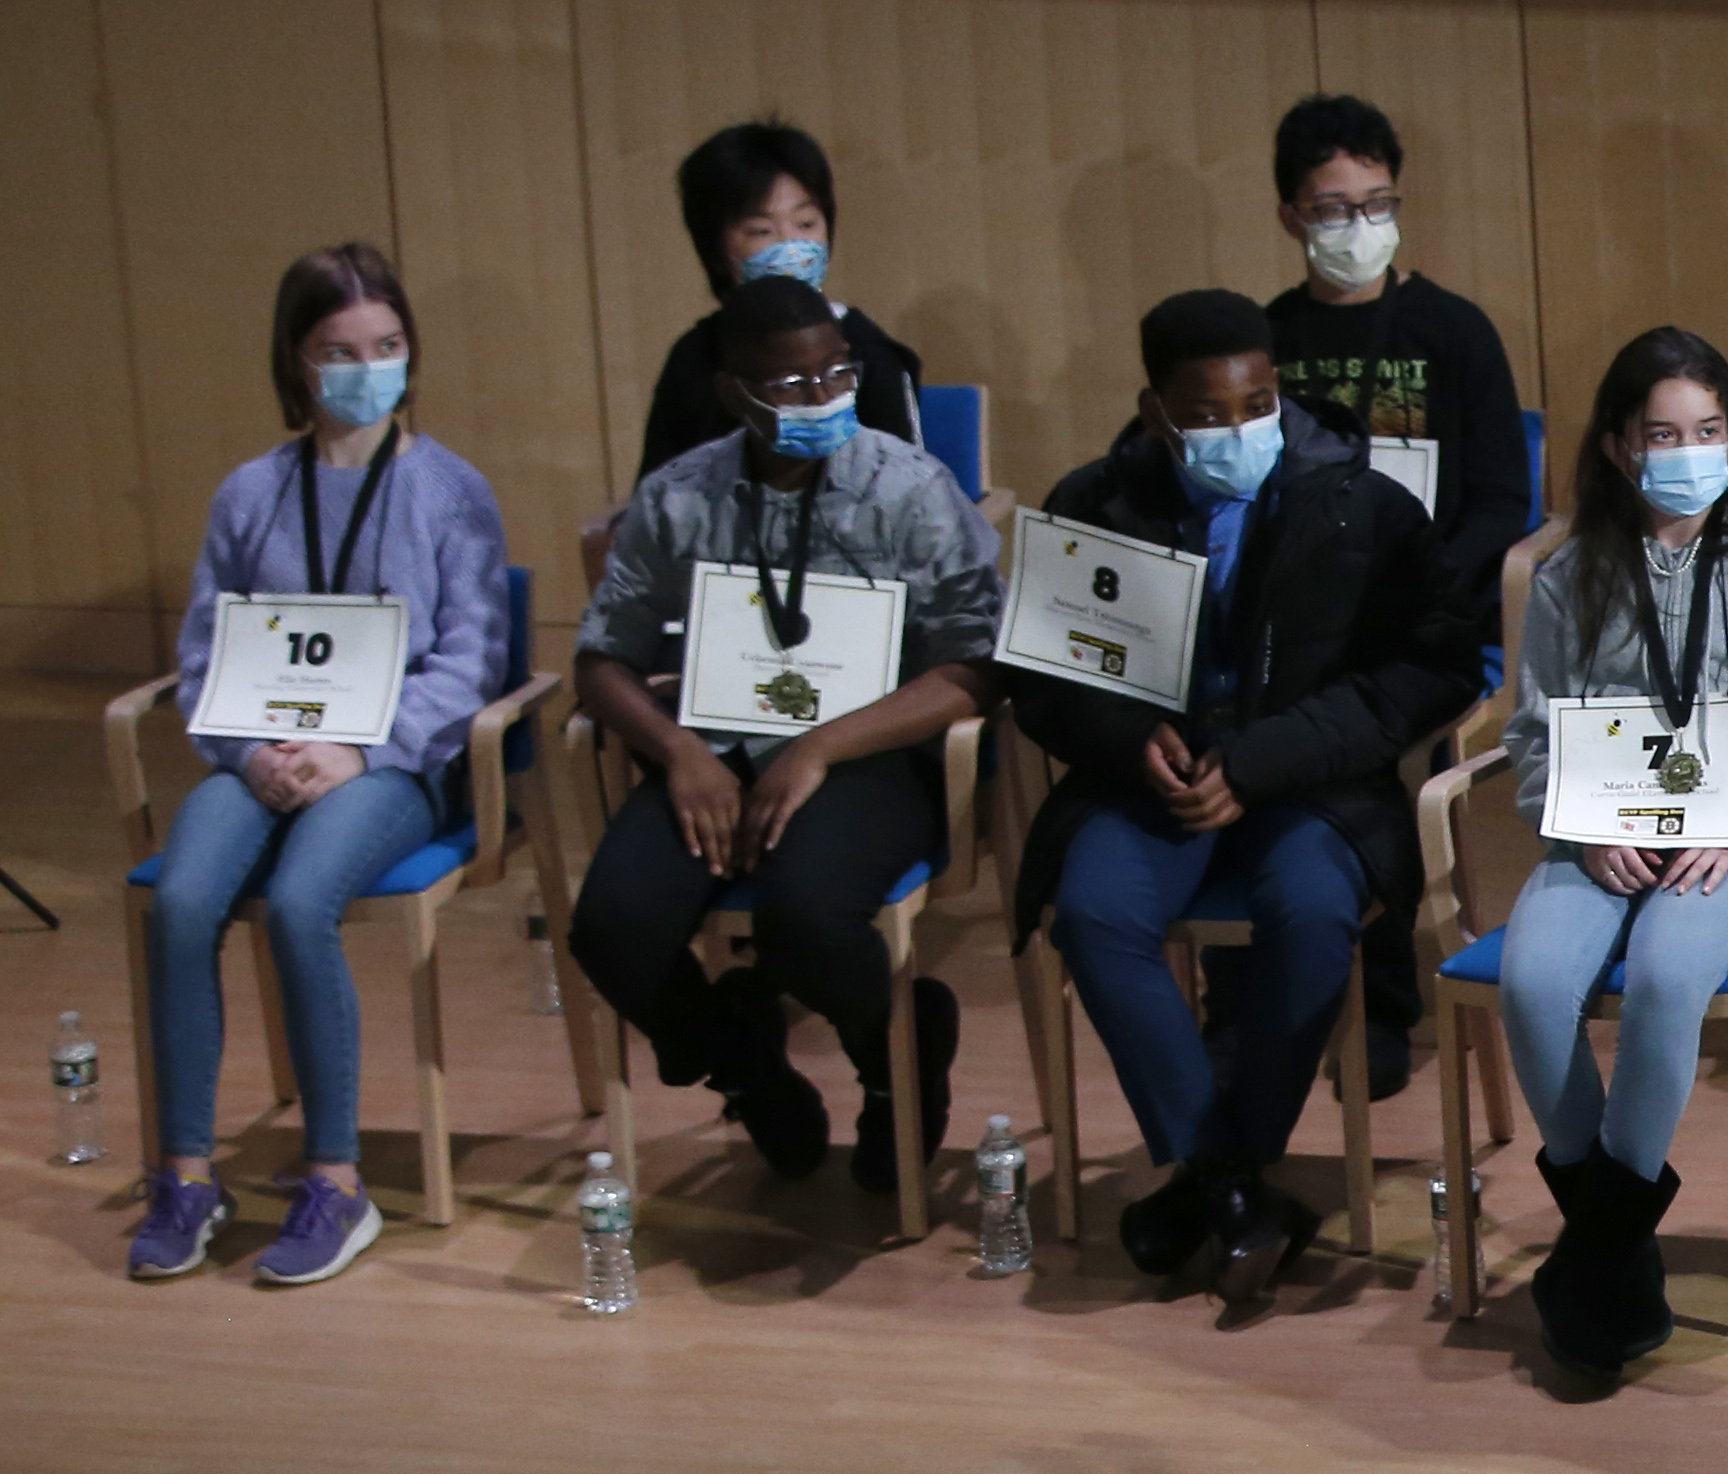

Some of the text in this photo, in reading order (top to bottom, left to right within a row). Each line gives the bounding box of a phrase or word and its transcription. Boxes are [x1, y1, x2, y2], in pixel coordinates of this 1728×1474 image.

[1093, 566, 1120, 603] 8
[287, 632, 333, 666] 10
[1642, 735, 1673, 770] 7
